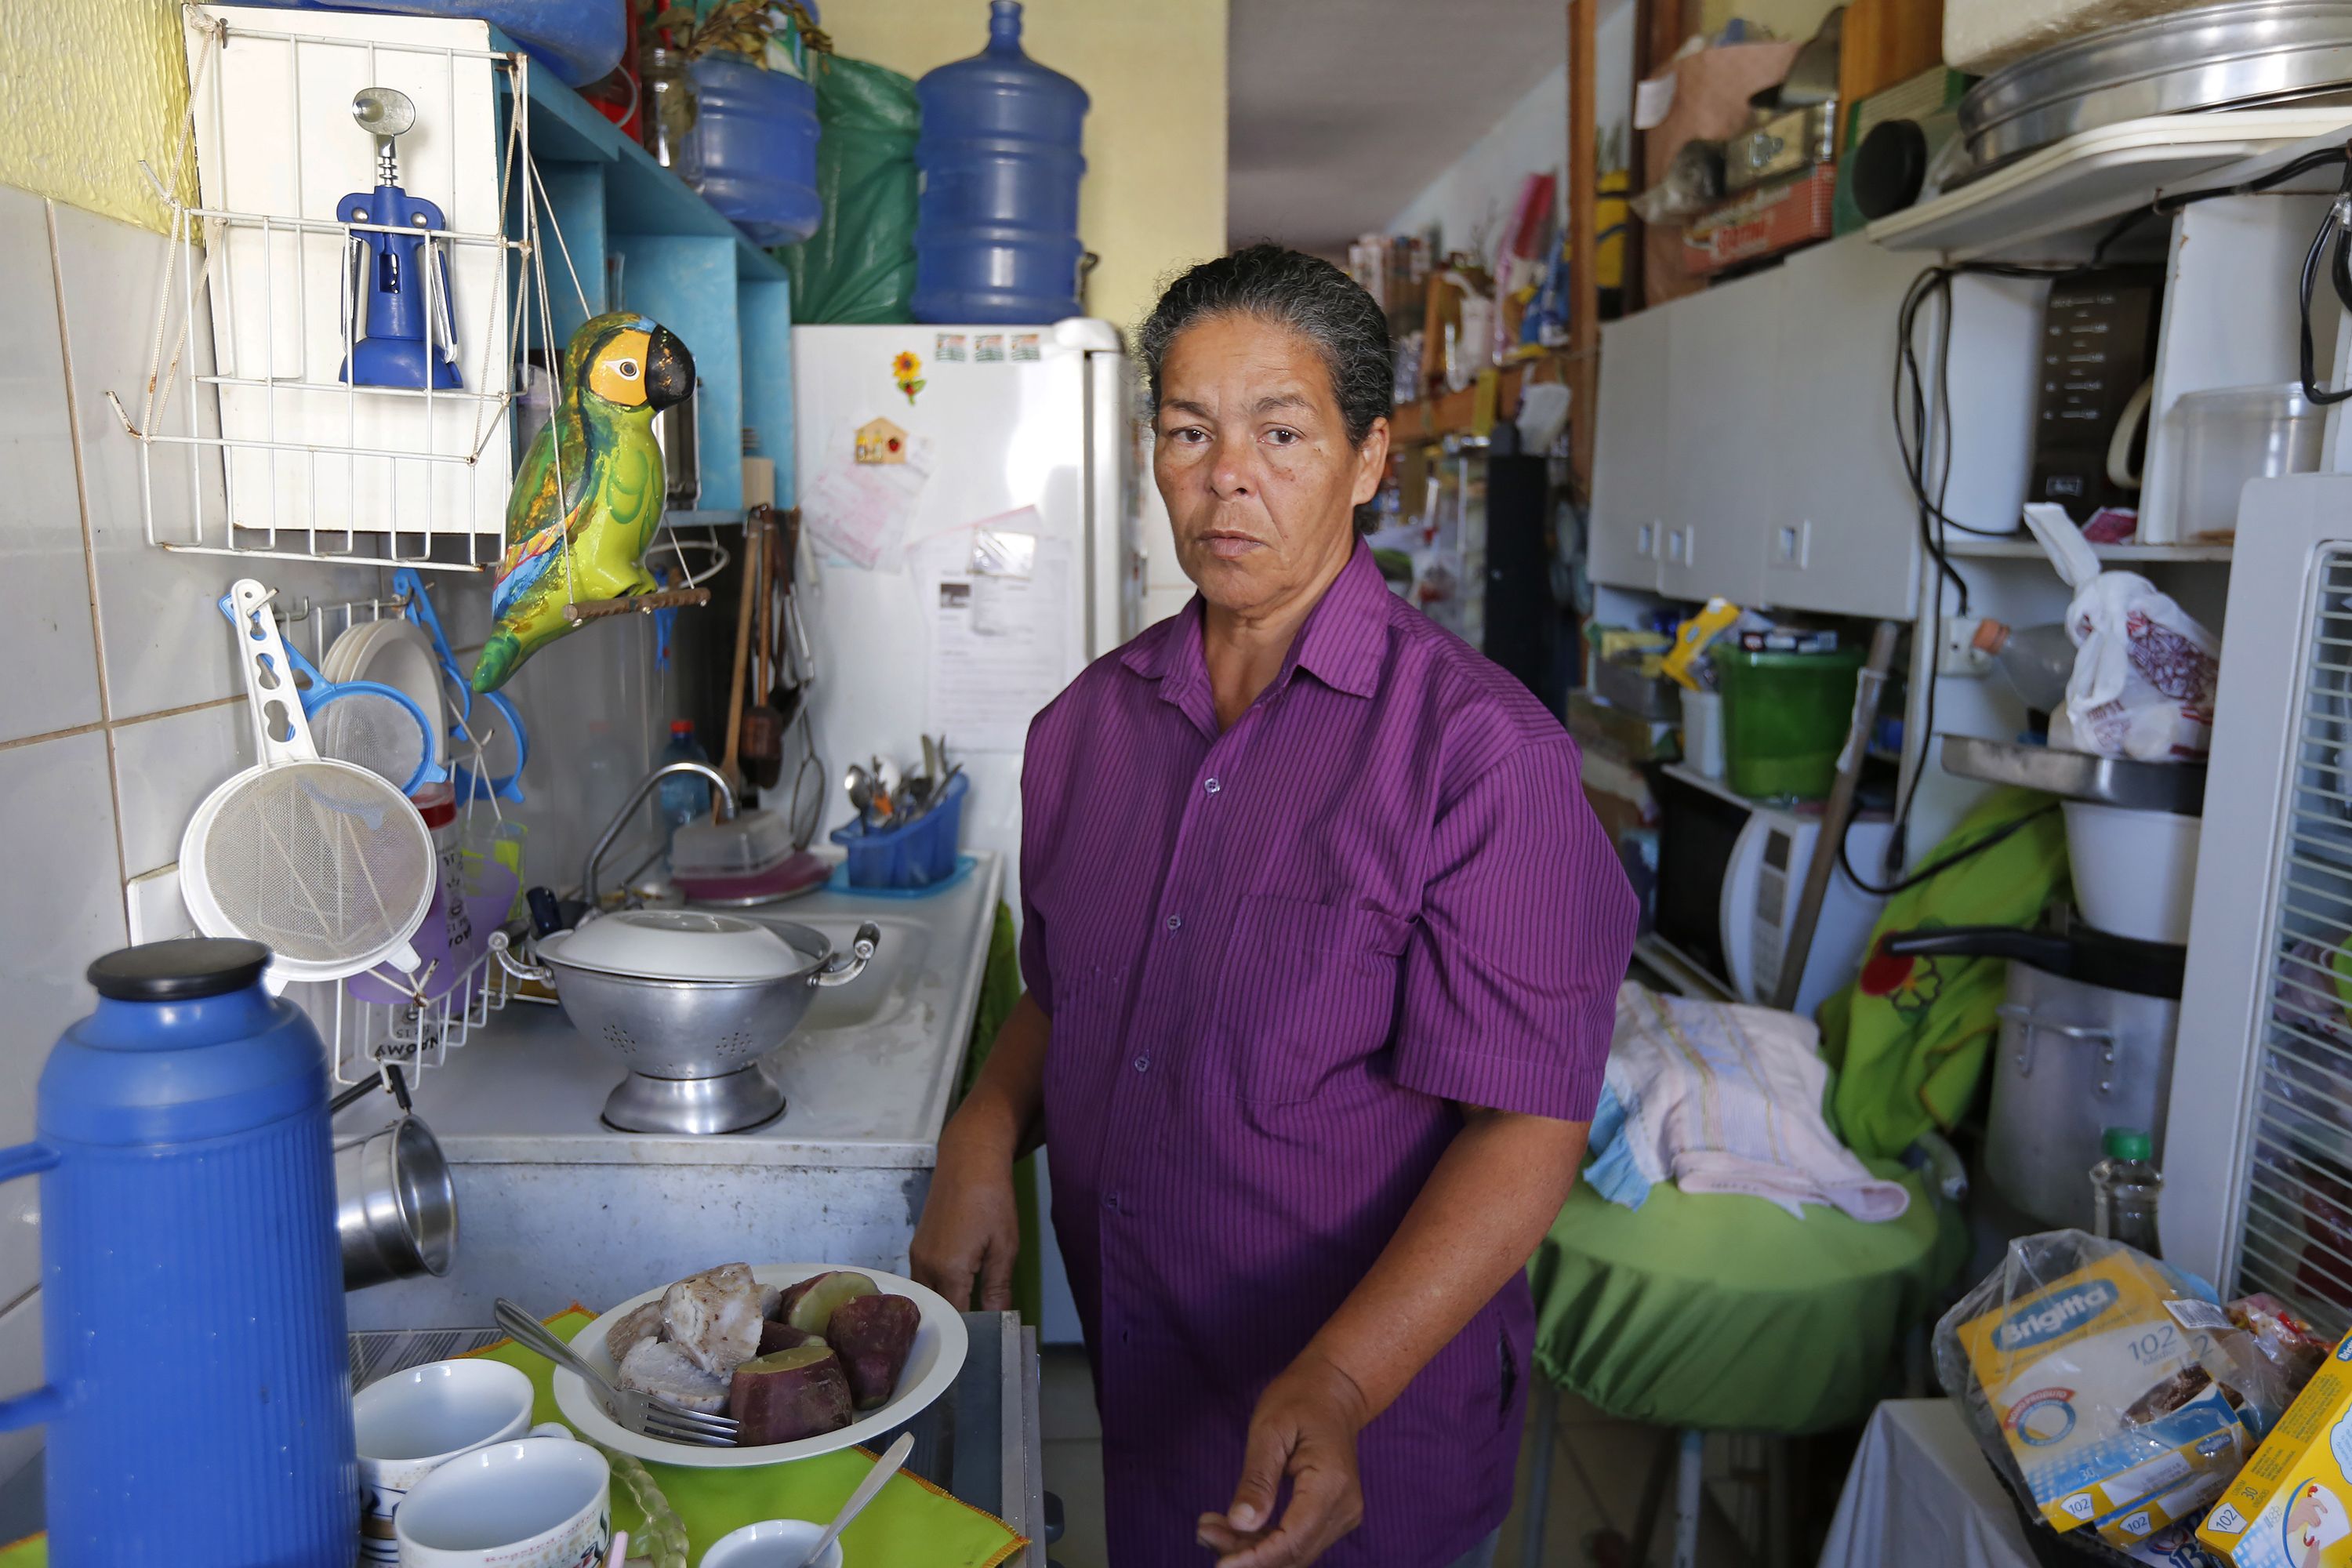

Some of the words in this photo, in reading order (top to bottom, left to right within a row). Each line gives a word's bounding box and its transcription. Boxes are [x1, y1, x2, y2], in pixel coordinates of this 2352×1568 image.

[1998, 1286, 2109, 1344] Brigitta
[2128, 1325, 2177, 1361] 102
[2241, 1486, 2259, 1501] 30
[2068, 1498, 2091, 1515] 102
[2126, 1516, 2147, 1532] 102
[2216, 1509, 2238, 1530] 102
